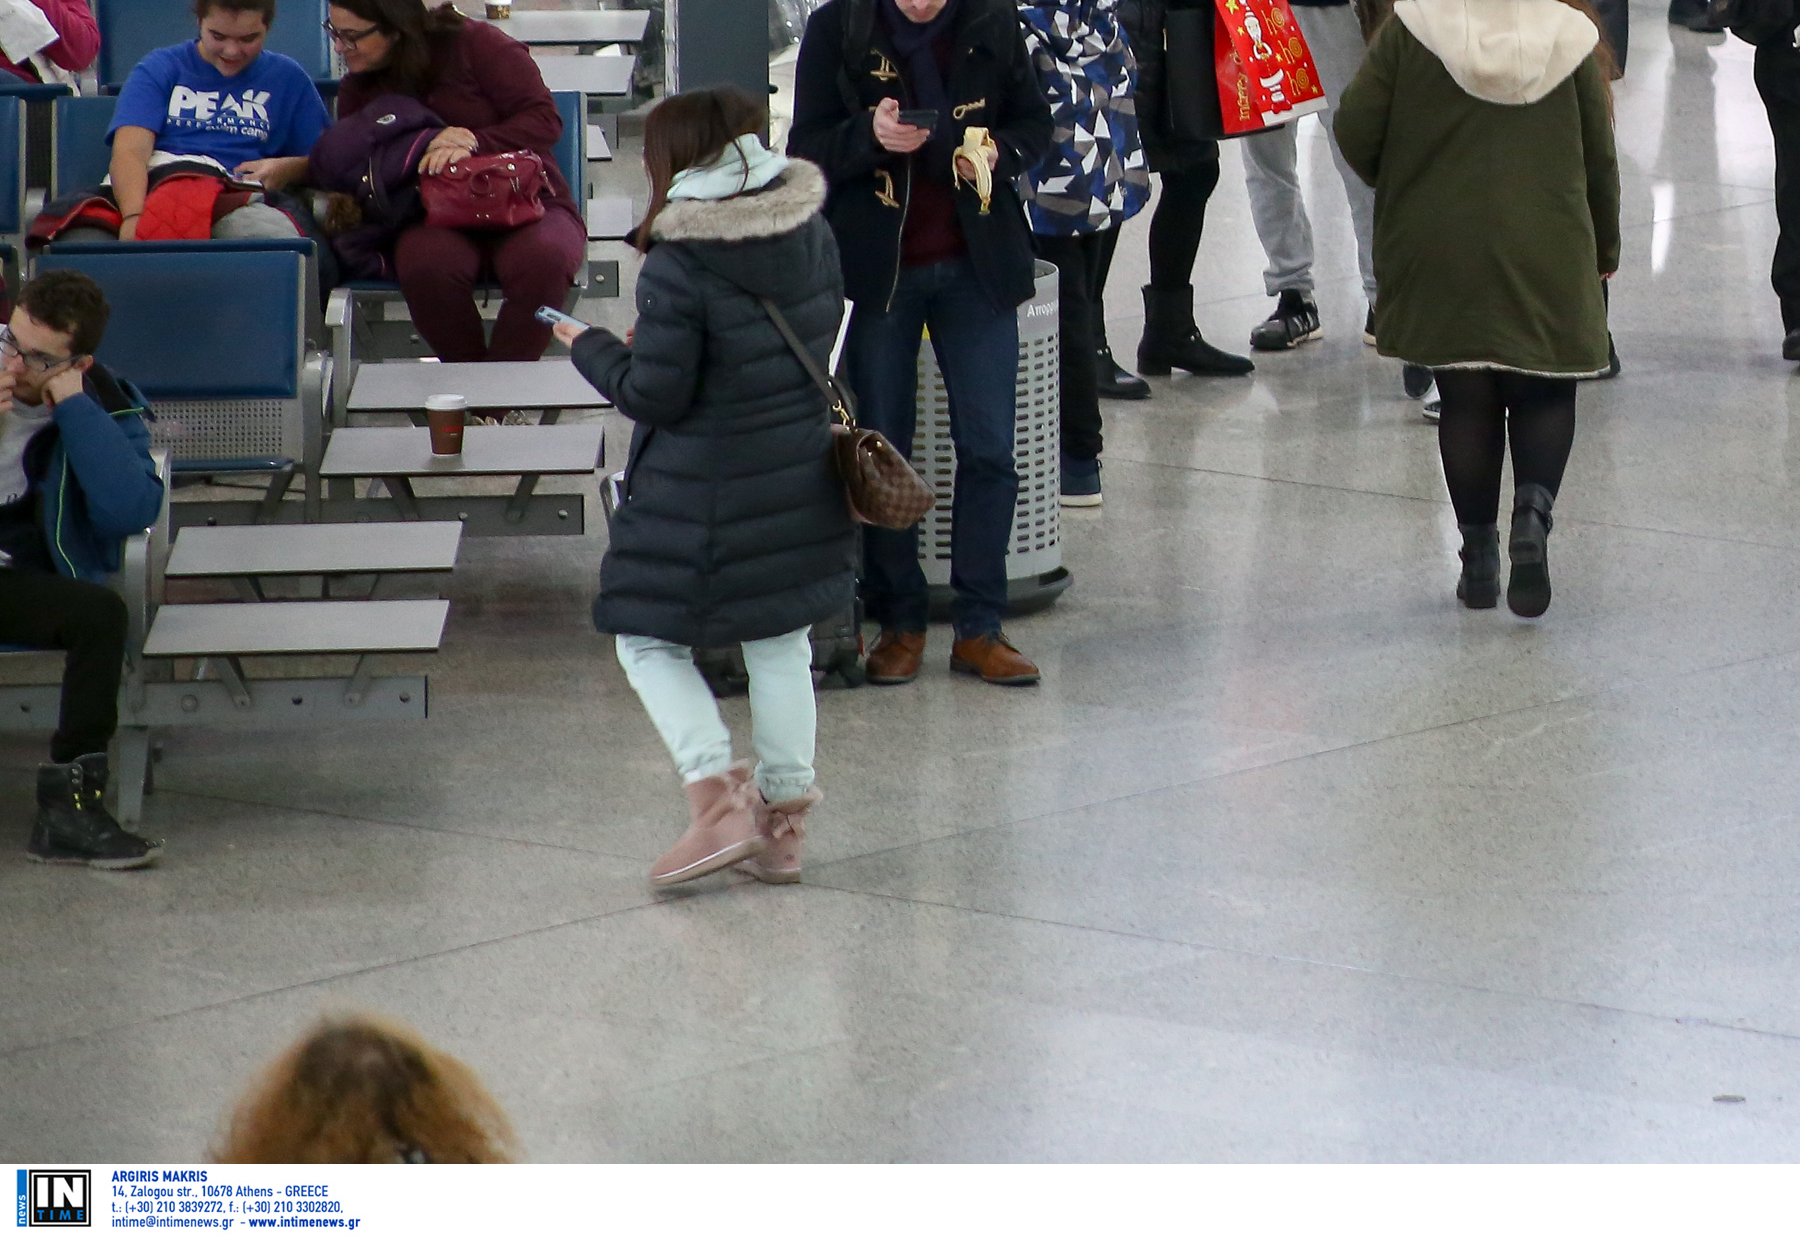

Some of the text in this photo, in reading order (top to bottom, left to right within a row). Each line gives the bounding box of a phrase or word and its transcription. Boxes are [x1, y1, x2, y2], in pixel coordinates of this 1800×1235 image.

[1261, 7, 1286, 36] ho
[1277, 36, 1304, 64] ho
[1286, 68, 1310, 96] ho
[168, 85, 271, 122] PEAK
